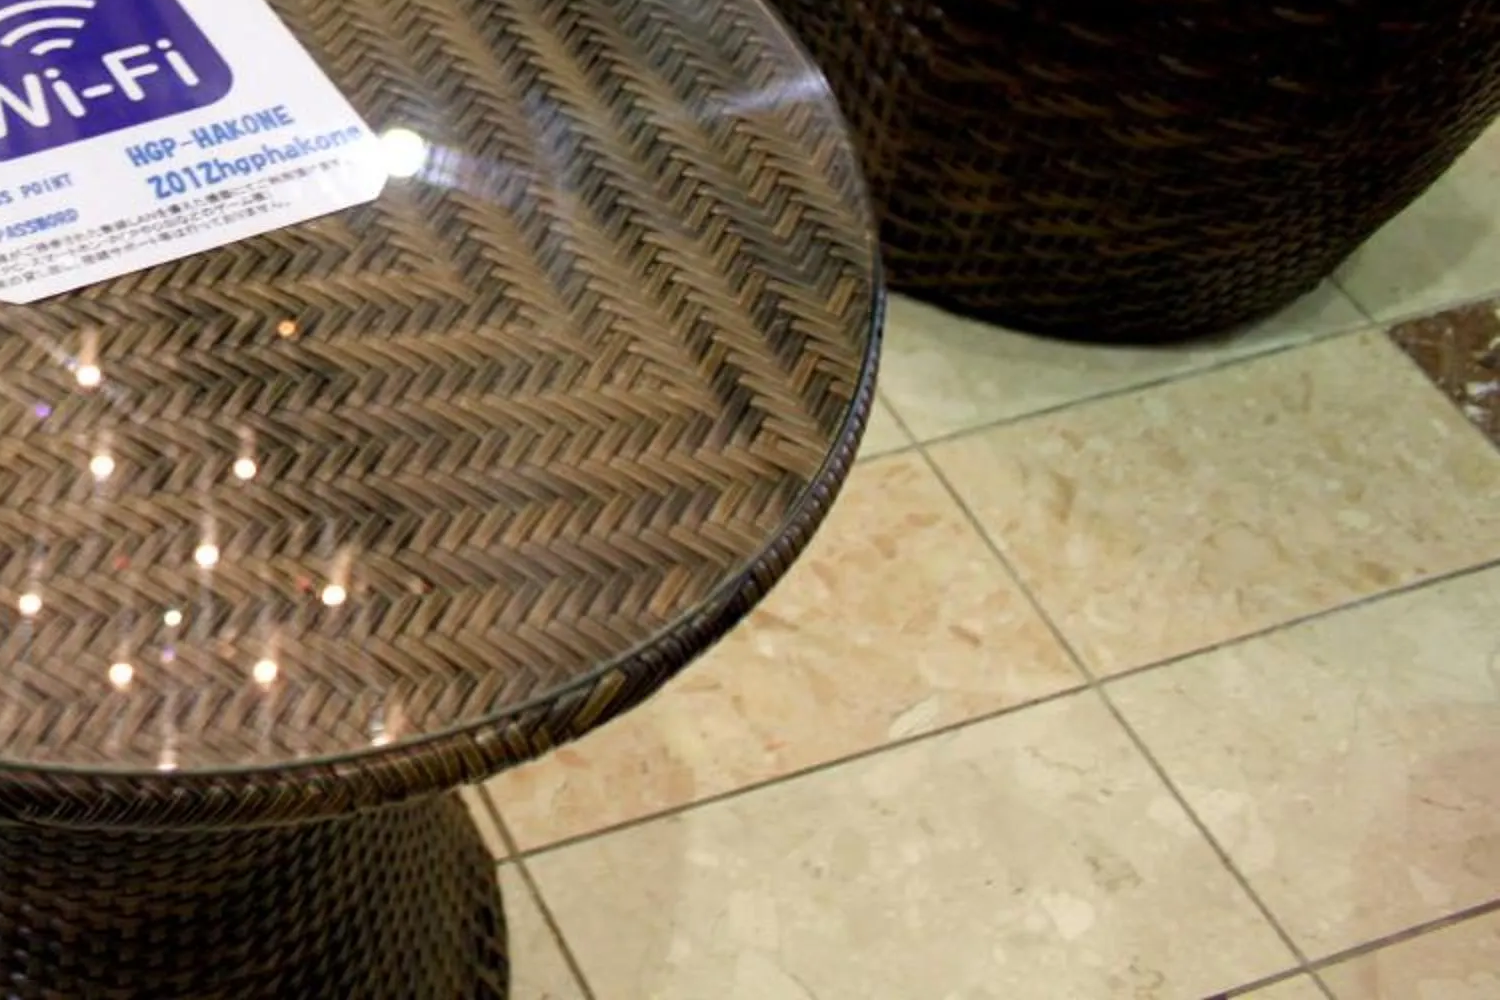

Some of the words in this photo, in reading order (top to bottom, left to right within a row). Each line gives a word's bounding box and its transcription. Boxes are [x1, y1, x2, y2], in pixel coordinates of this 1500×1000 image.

[127, 103, 296, 168] HGP-HAKONE
[147, 124, 364, 200] 2012hgphakone
[20, 172, 74, 199] POINT
